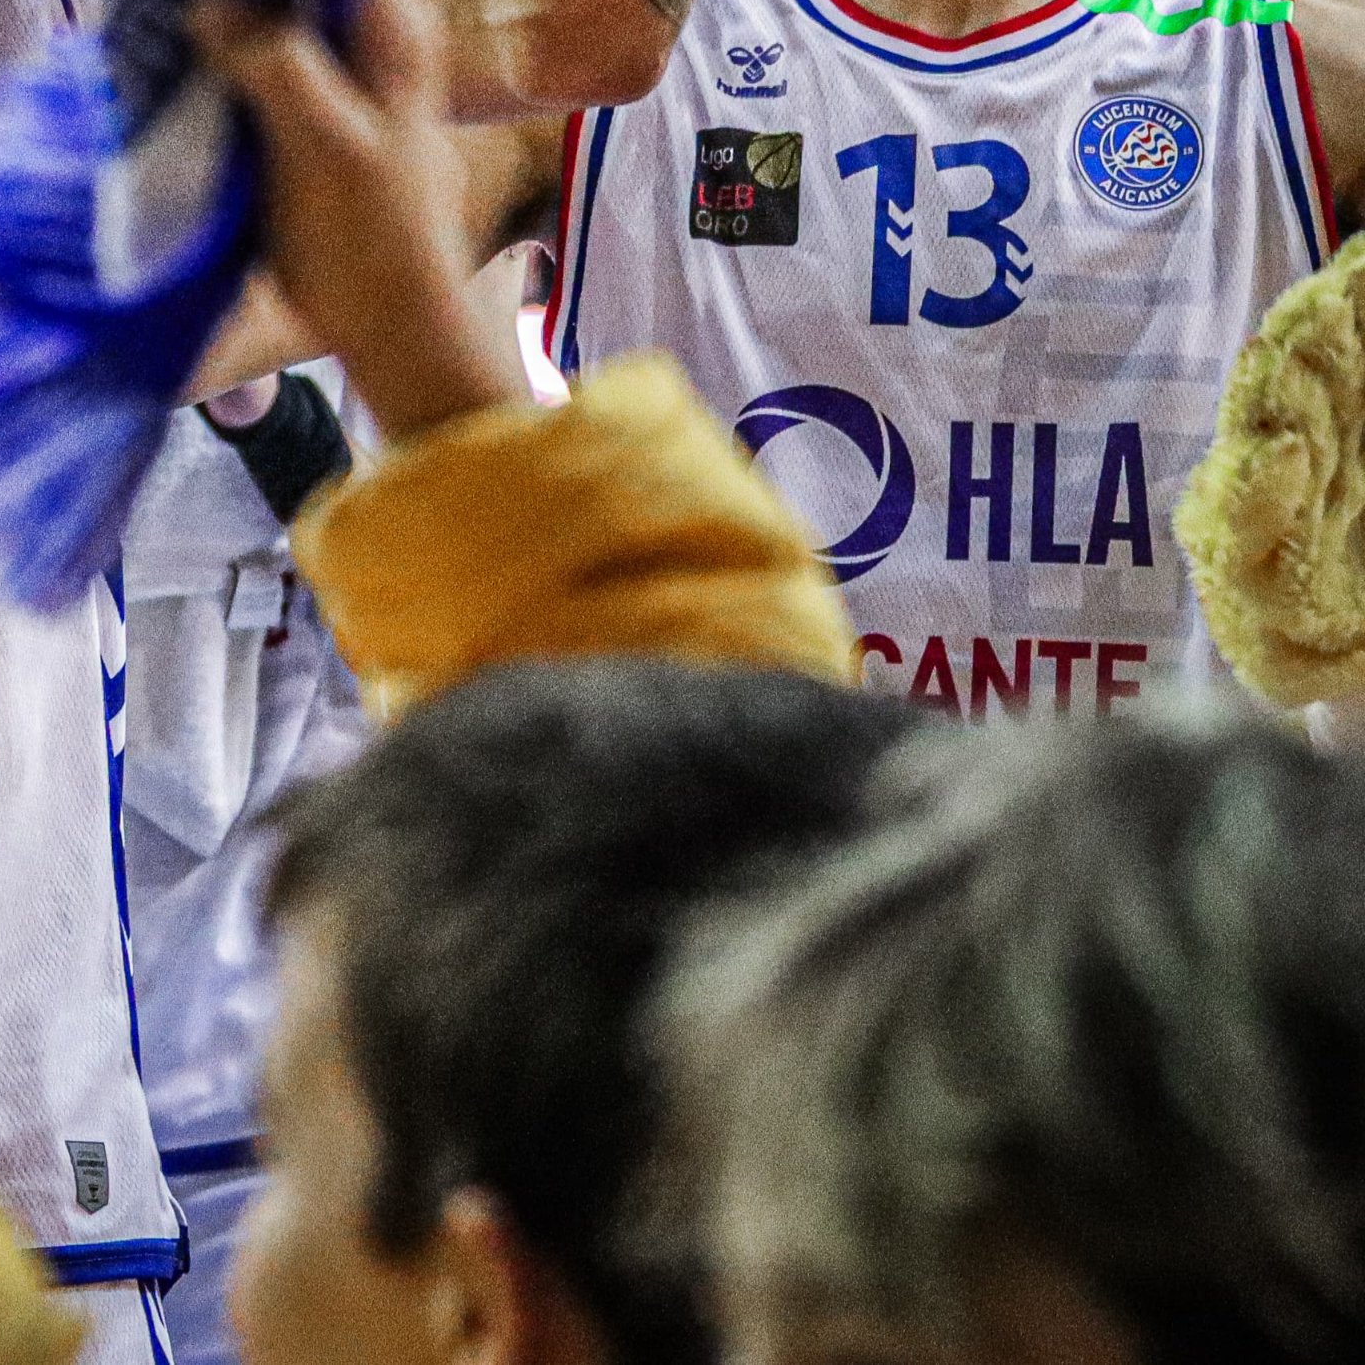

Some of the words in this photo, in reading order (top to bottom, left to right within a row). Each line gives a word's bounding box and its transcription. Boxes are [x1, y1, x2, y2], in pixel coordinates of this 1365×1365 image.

[717, 78, 788, 99] hummel
[1092, 103, 1183, 132] LUCENTUM
[700, 144, 734, 170] Liga
[1099, 178, 1181, 203] ALICANTE
[835, 133, 1034, 328] 13
[945, 421, 1154, 568] HLA
